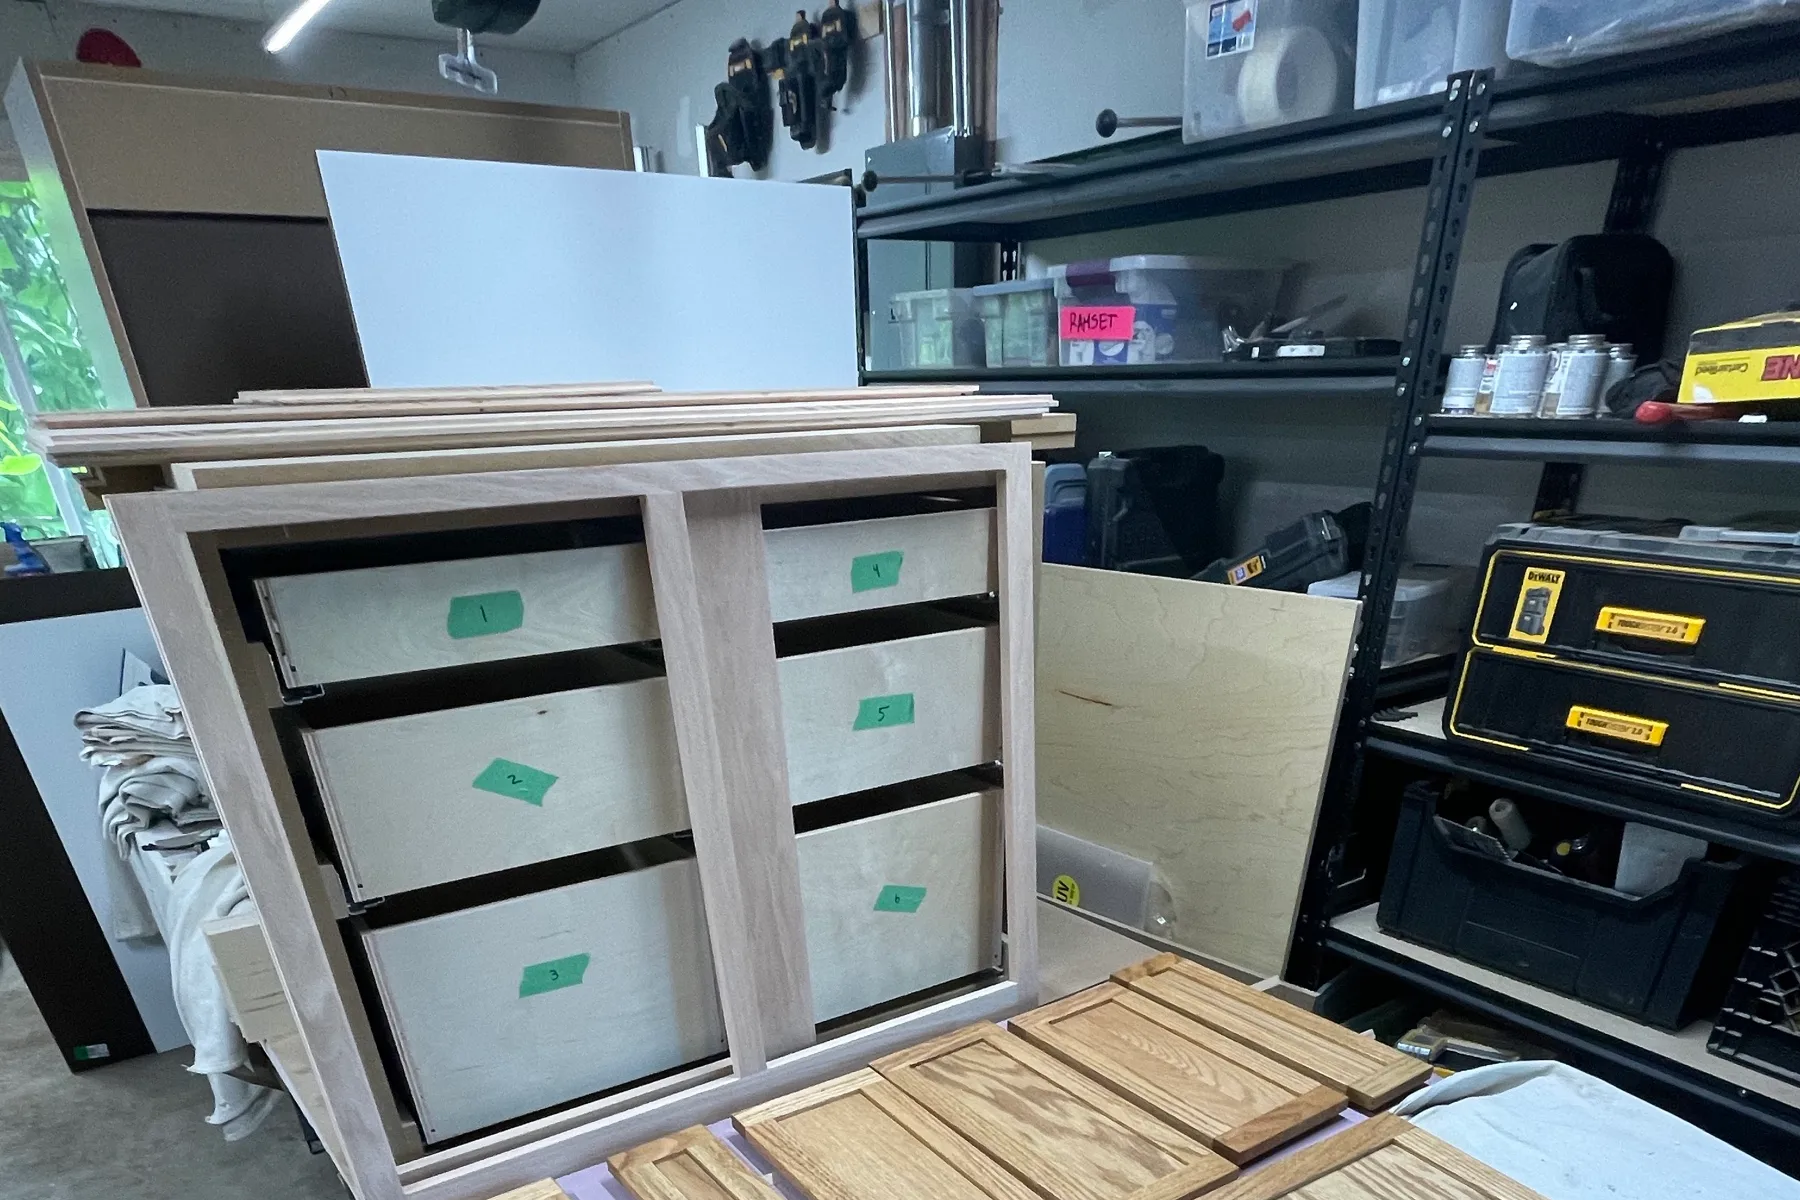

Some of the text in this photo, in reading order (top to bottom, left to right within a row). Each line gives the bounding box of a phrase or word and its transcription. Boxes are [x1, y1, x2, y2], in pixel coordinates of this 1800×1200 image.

[872, 563, 881, 578] 4
[479, 603, 488, 623] 1
[877, 705, 890, 722] 5
[506, 774, 524, 785] 2
[894, 893, 901, 905] 6
[1056, 880, 1070, 903] UV
[549, 969, 559, 981] 3
